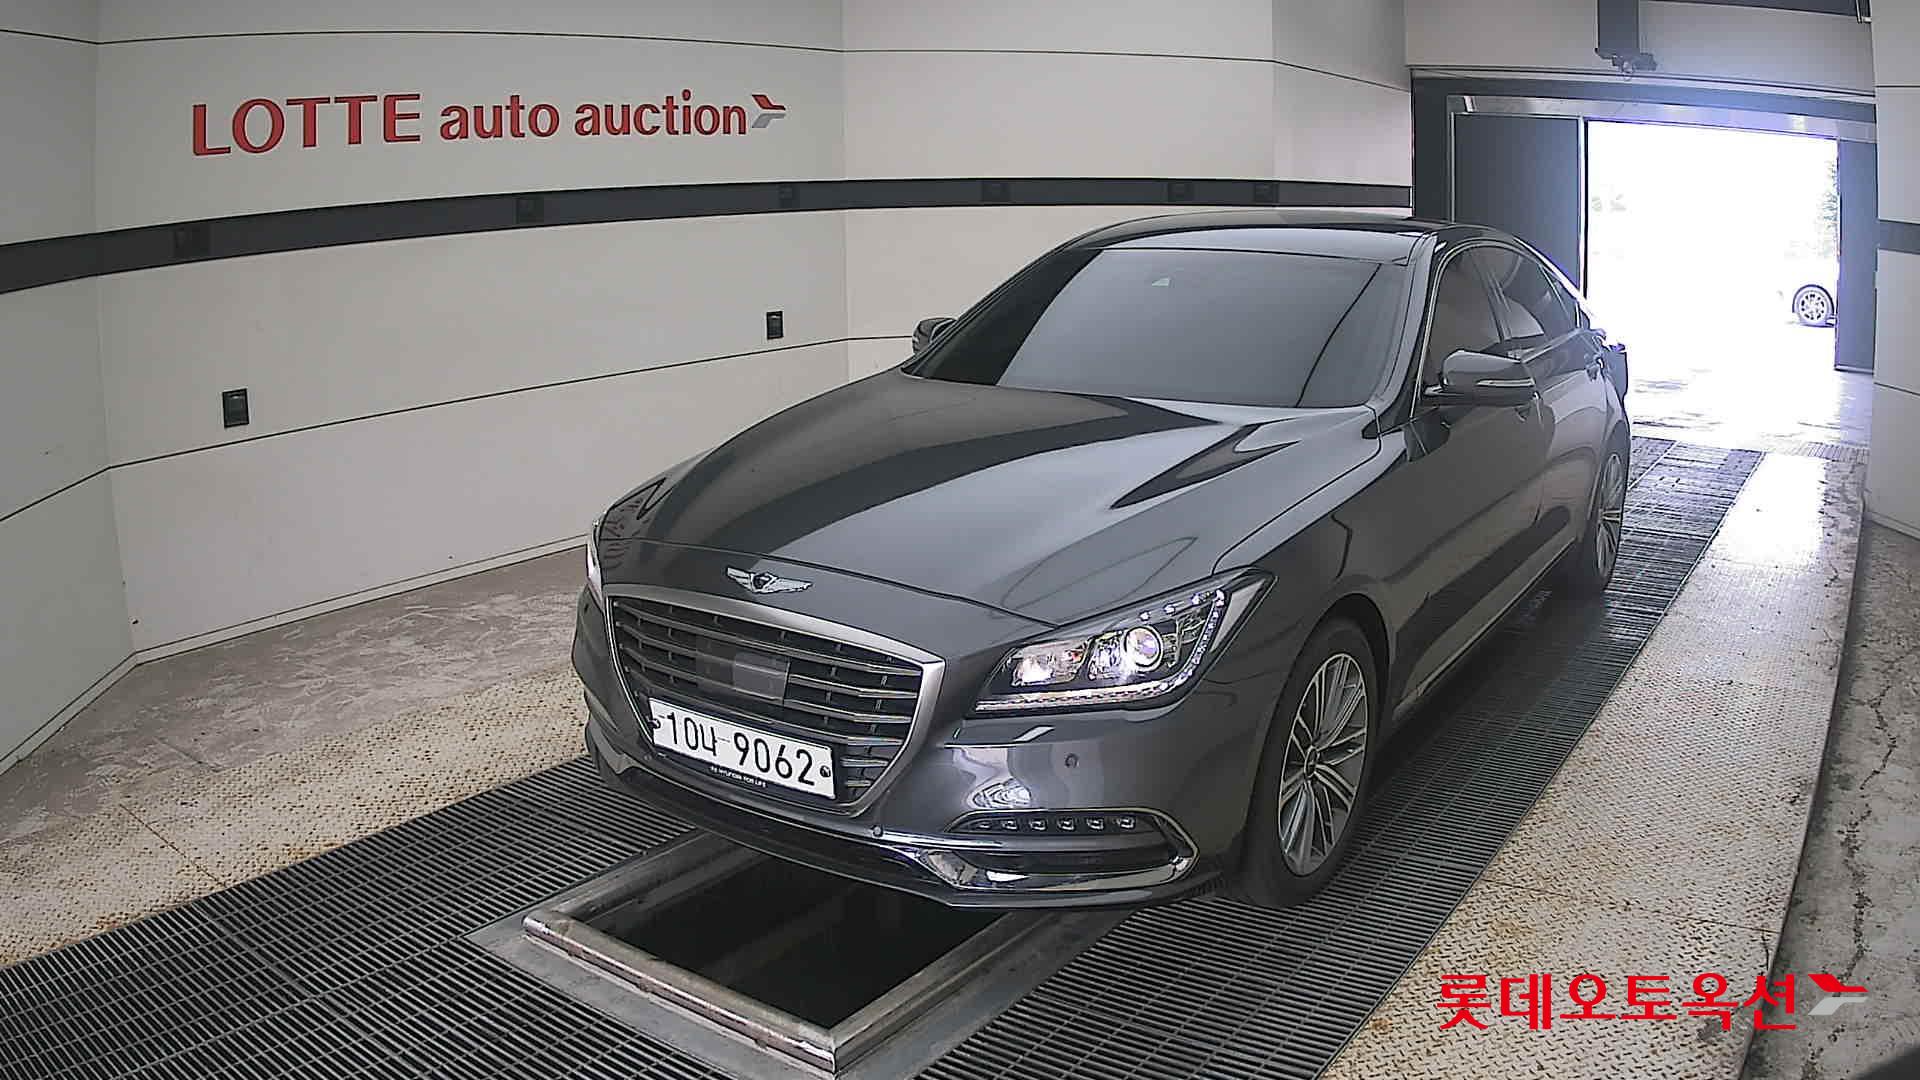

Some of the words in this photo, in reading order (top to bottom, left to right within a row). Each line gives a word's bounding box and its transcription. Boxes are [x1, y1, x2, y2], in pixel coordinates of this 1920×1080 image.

[192, 94, 421, 156] LOTTE
[440, 94, 559, 140] auto
[574, 89, 747, 136] auction
[733, 732, 815, 786] 9062
